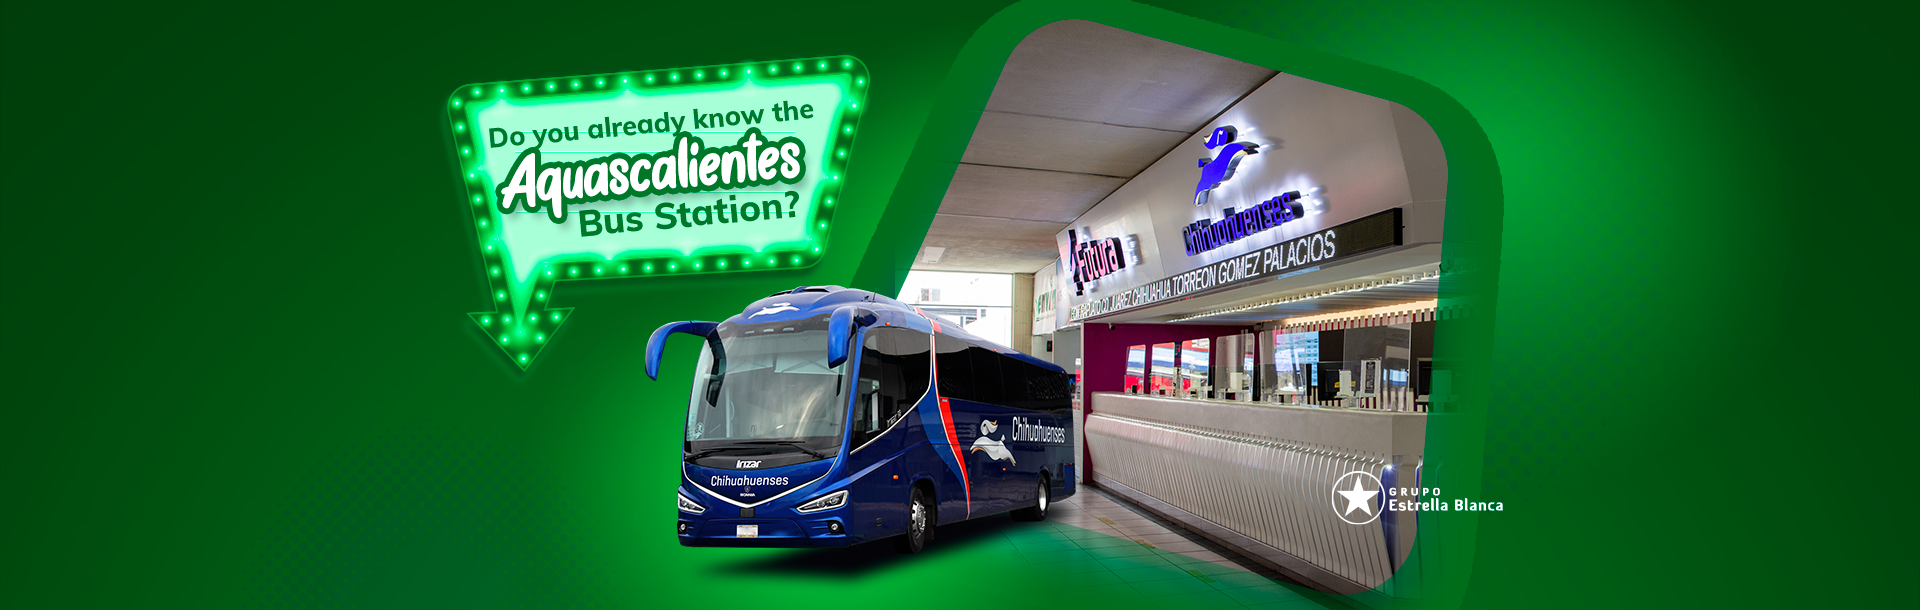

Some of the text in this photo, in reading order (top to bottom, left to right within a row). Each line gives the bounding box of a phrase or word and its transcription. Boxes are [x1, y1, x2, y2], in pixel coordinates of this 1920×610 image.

[488, 100, 815, 151] Do you already know the
[579, 190, 800, 238] Bus Station?
[1182, 192, 1295, 257] Chihuahuenses
[1075, 238, 1120, 282] Futura
[1132, 278, 1172, 306] CHIHUAHUA
[1172, 267, 1217, 296] TORREON
[1218, 251, 1261, 284] GOMEZ
[1263, 229, 1336, 274] PALACIOS
[1012, 416, 1066, 443] Chihuahuenses
[711, 475, 789, 487] Chihuahuenses
